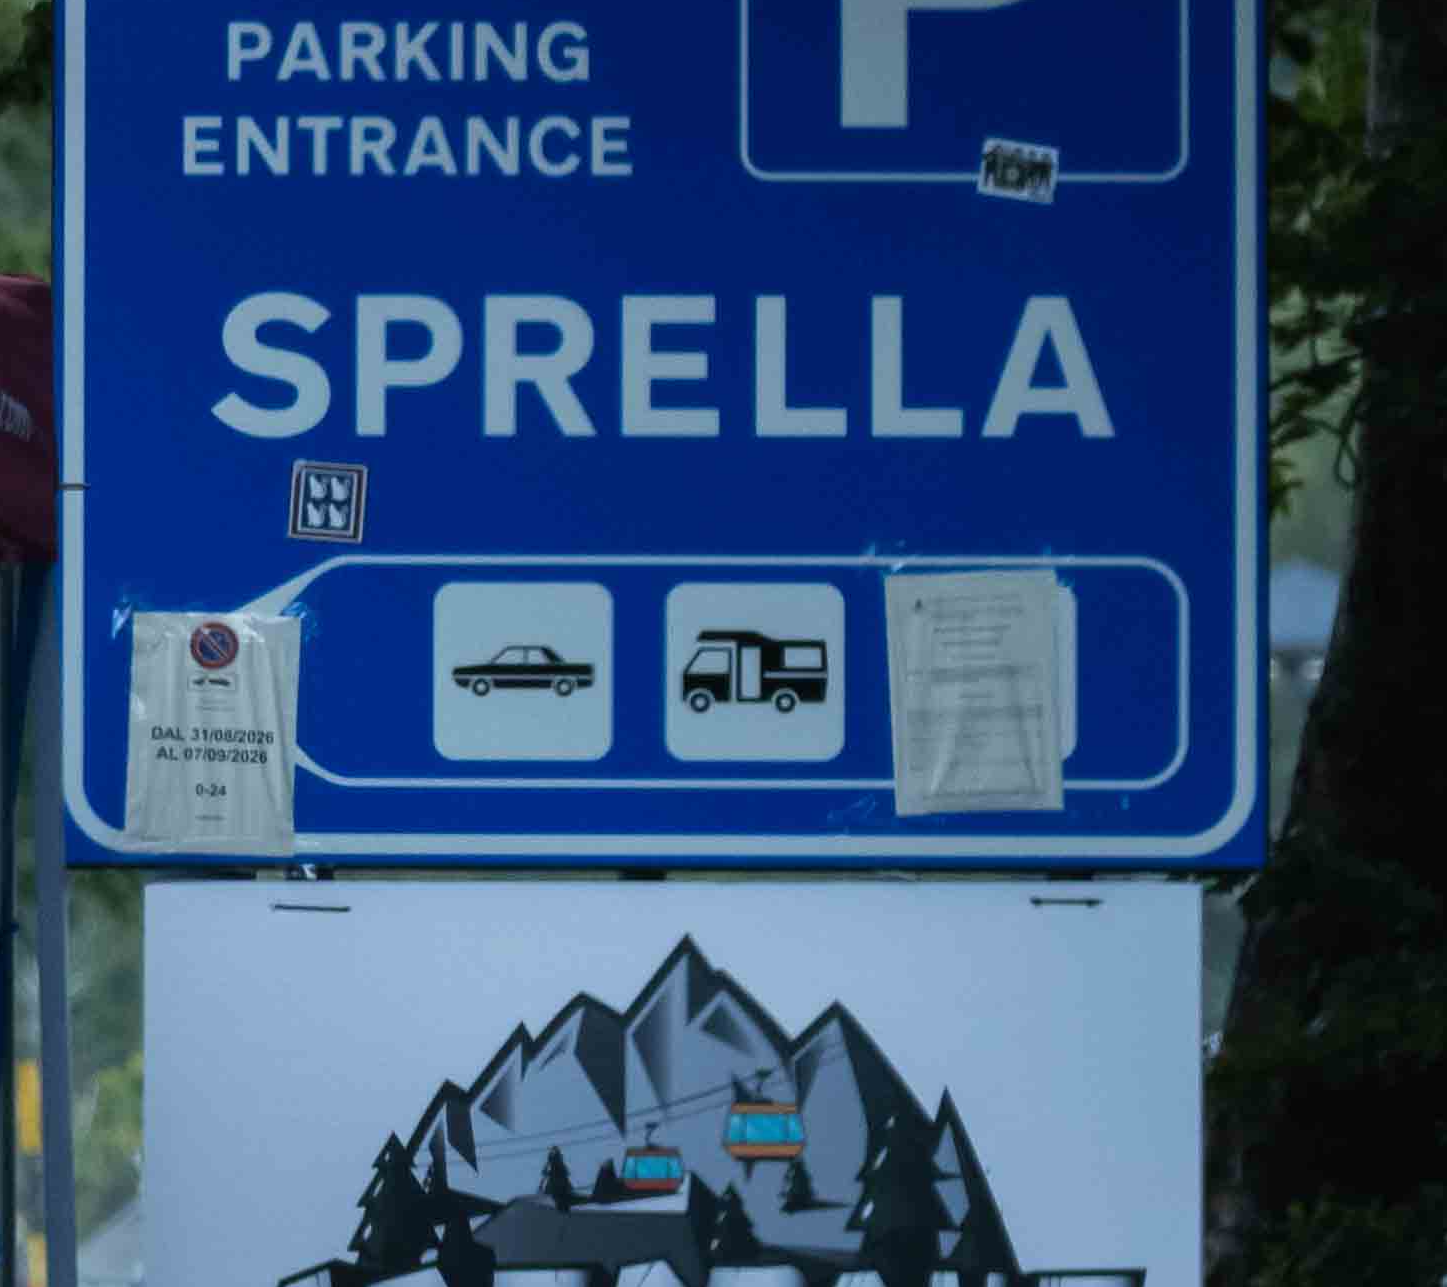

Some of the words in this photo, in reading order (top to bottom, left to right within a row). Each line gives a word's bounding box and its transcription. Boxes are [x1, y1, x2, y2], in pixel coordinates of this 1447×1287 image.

[225, 20, 591, 83] PARKING
[181, 114, 634, 178] ENTRANCE
[209, 290, 1115, 440] SPRELLA
[150, 725, 185, 741] DAL
[155, 745, 179, 761] AL
[195, 782, 228, 797] 0-24
